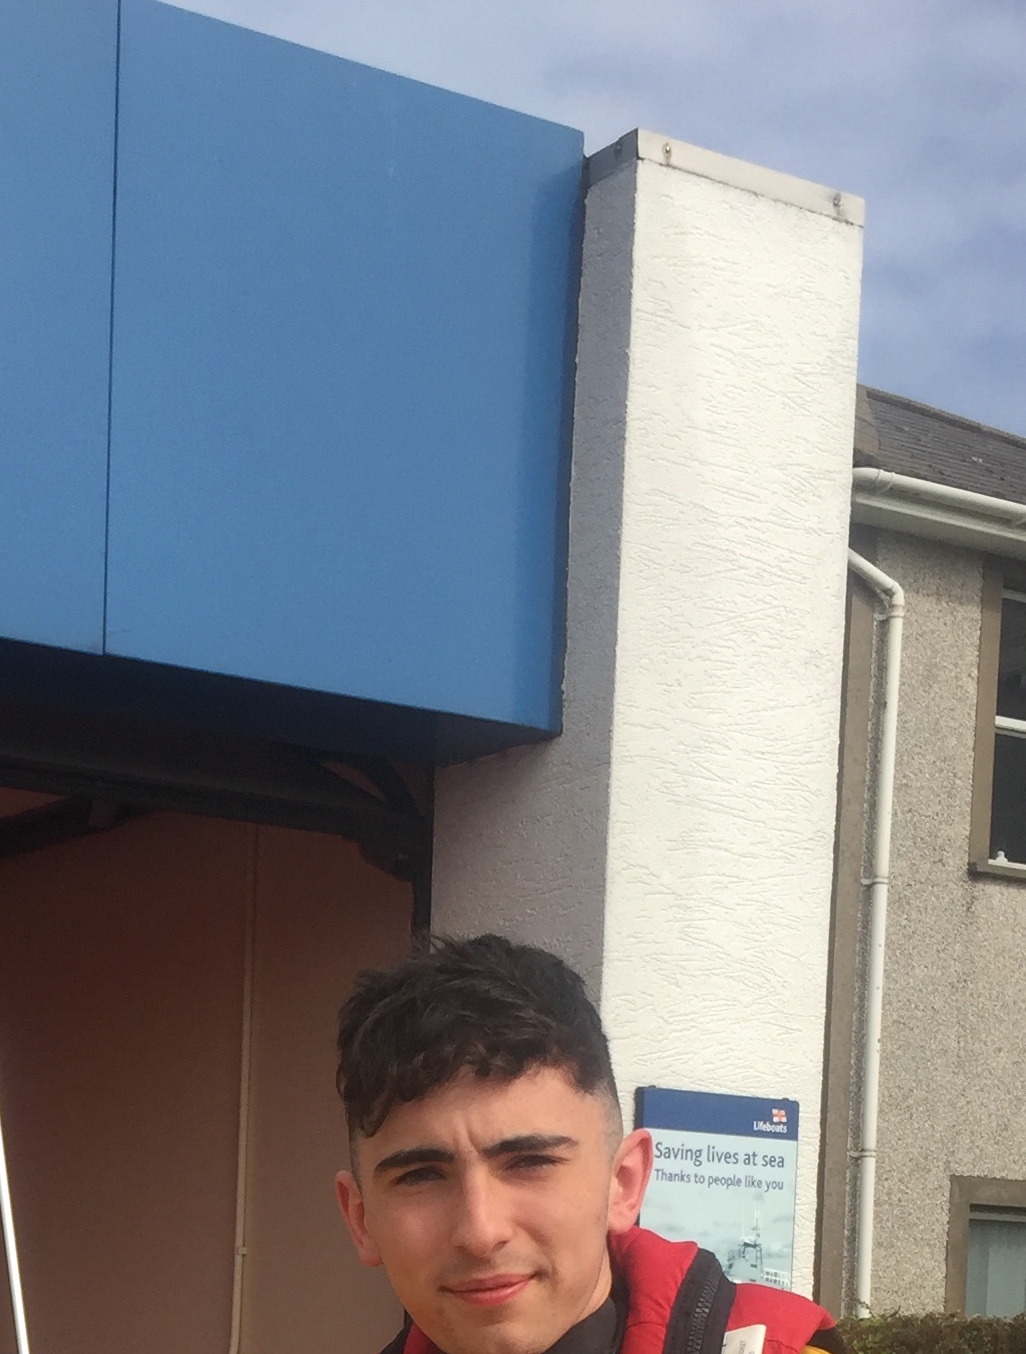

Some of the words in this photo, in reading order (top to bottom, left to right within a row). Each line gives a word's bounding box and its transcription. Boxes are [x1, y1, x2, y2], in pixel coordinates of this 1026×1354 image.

[753, 1121, 787, 1133] Lifeboats
[654, 1142, 703, 1166] Saving
[707, 1145, 739, 1165] lives
[743, 1151, 758, 1166] at
[761, 1154, 785, 1168] sea
[654, 1169, 691, 1184] Thanks
[694, 1173, 705, 1184] to
[708, 1174, 742, 1190] people
[744, 1175, 762, 1188] like
[764, 1178, 784, 1192] you
